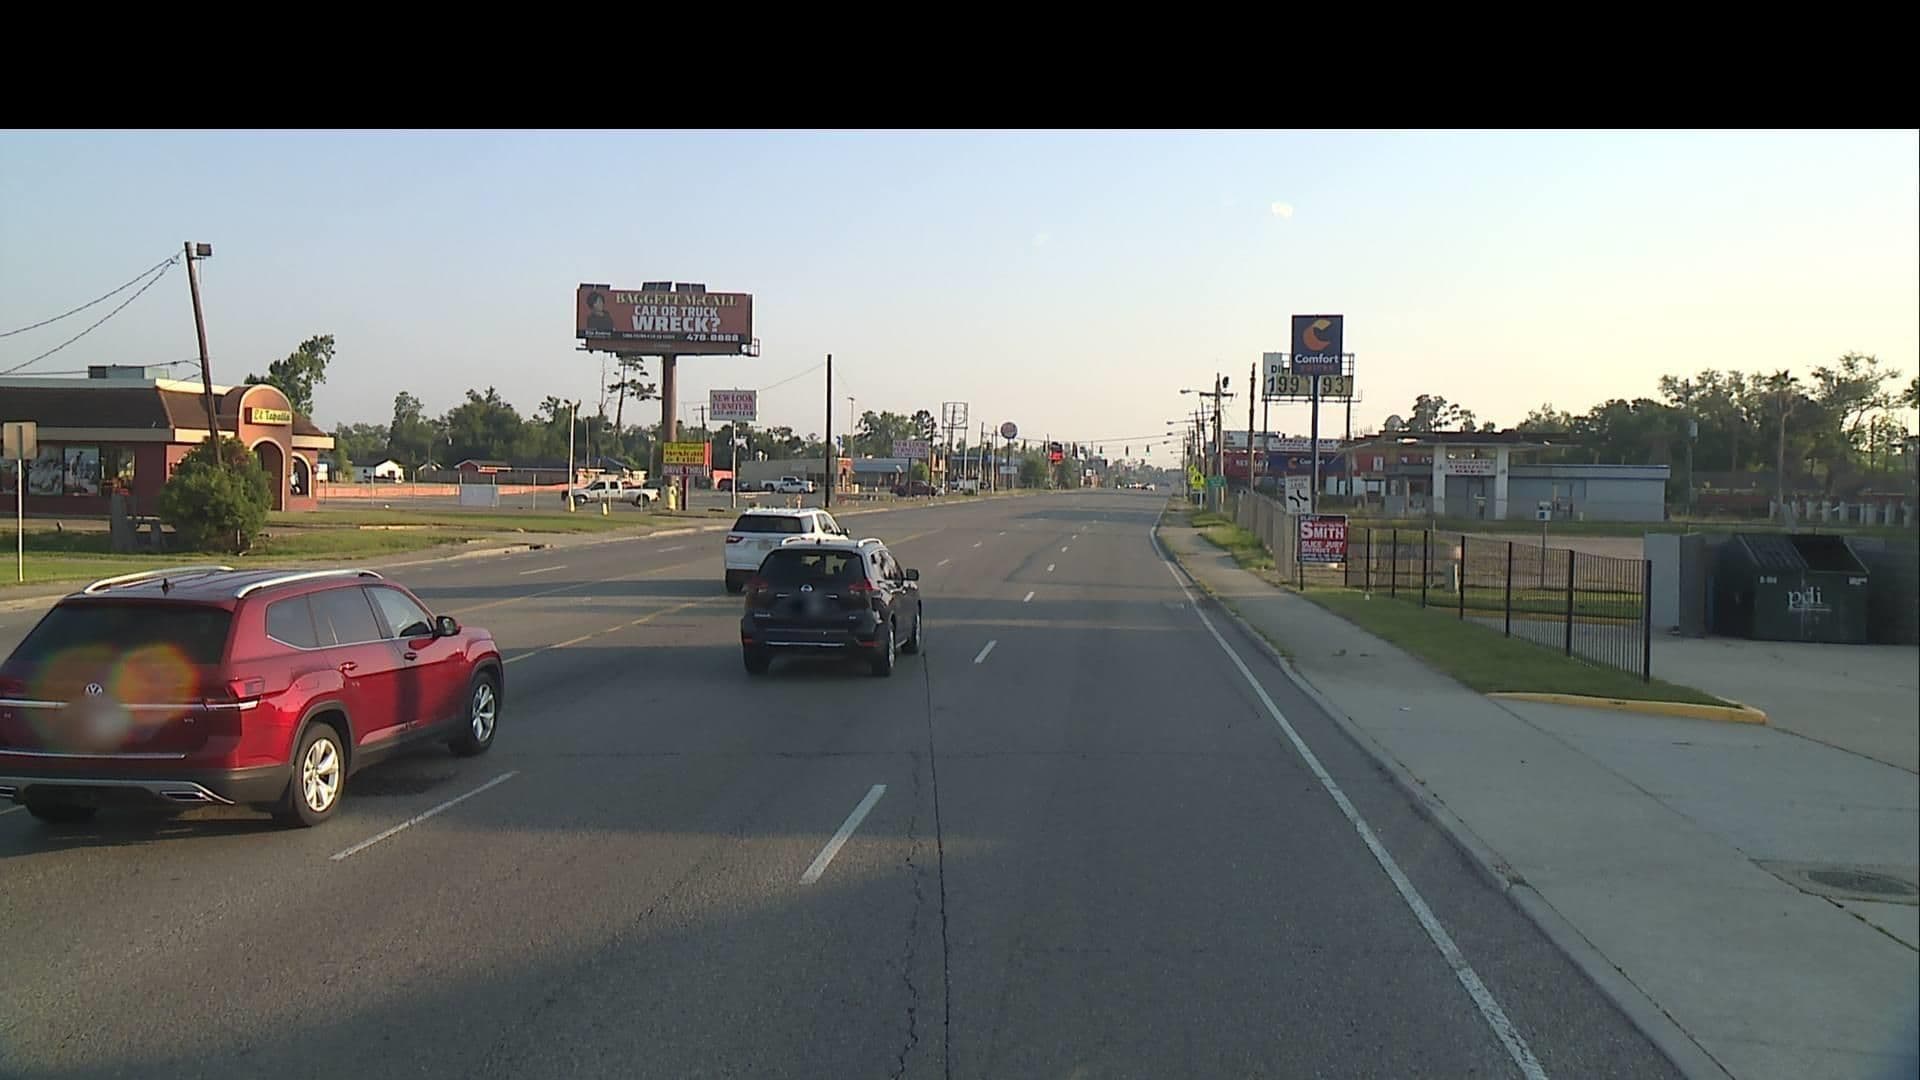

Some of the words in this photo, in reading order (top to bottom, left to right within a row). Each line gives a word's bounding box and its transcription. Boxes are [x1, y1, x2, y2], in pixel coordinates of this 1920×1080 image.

[616, 292, 681, 305] BAGGETT
[634, 305, 657, 316] CAR
[661, 306, 677, 317] OR
[681, 306, 718, 317] TRUCK
[632, 315, 721, 333] WRECK?
[1295, 353, 1339, 364] Comfort
[1300, 522, 1344, 540] SMITH
[1788, 586, 1822, 609] pdi
